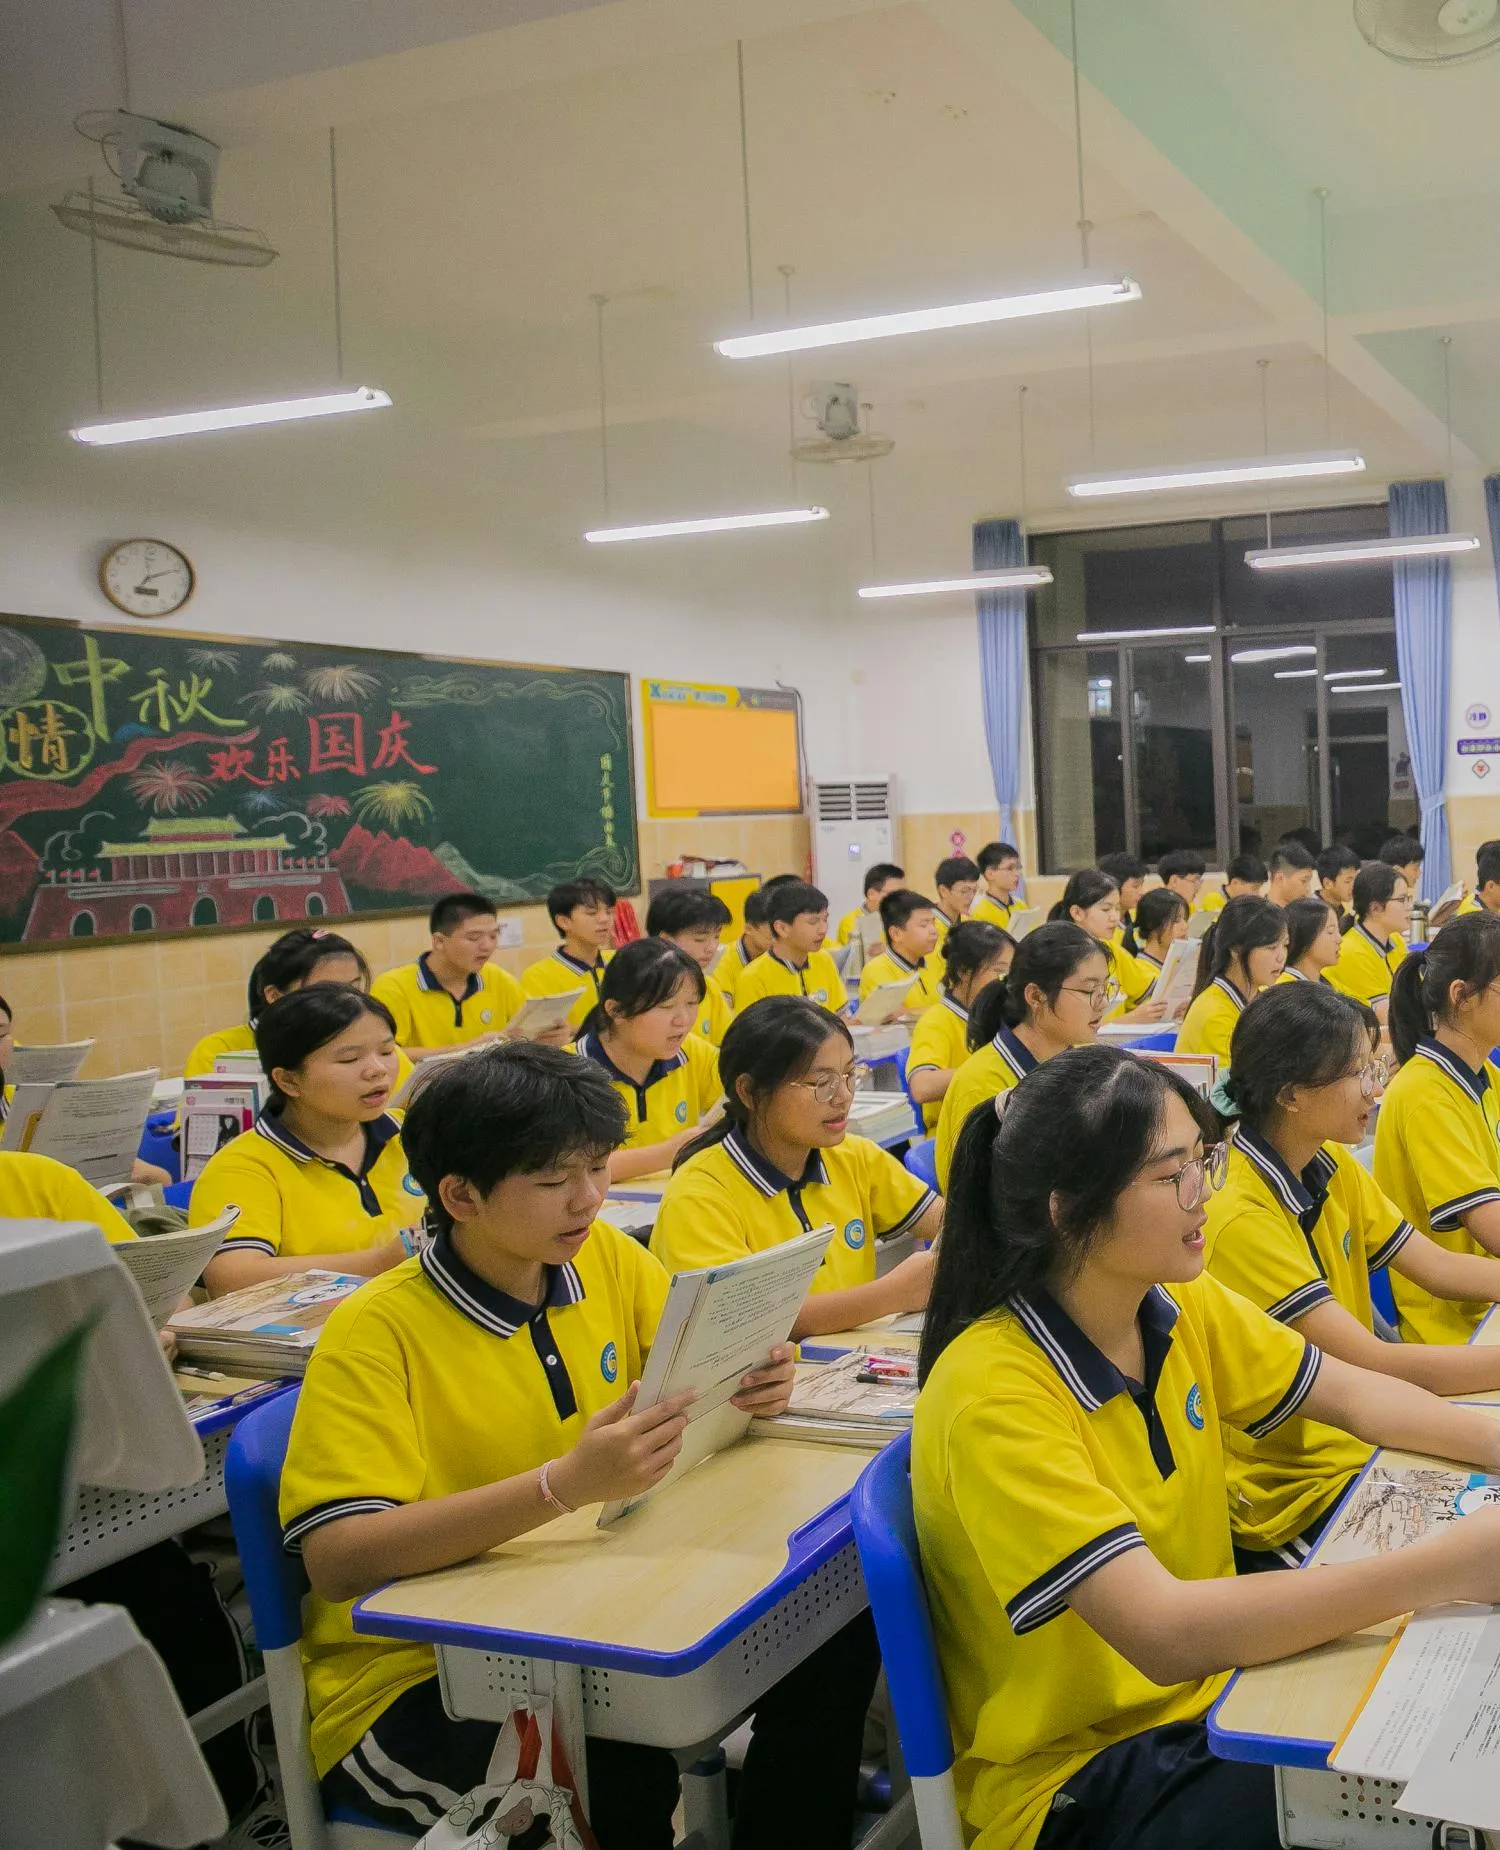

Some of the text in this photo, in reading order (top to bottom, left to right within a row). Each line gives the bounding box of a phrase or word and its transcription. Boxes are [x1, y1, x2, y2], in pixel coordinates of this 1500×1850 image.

[50, 634, 248, 743] 中秋
[9, 702, 77, 772] 情
[207, 710, 439, 786] 欢乐国庆
